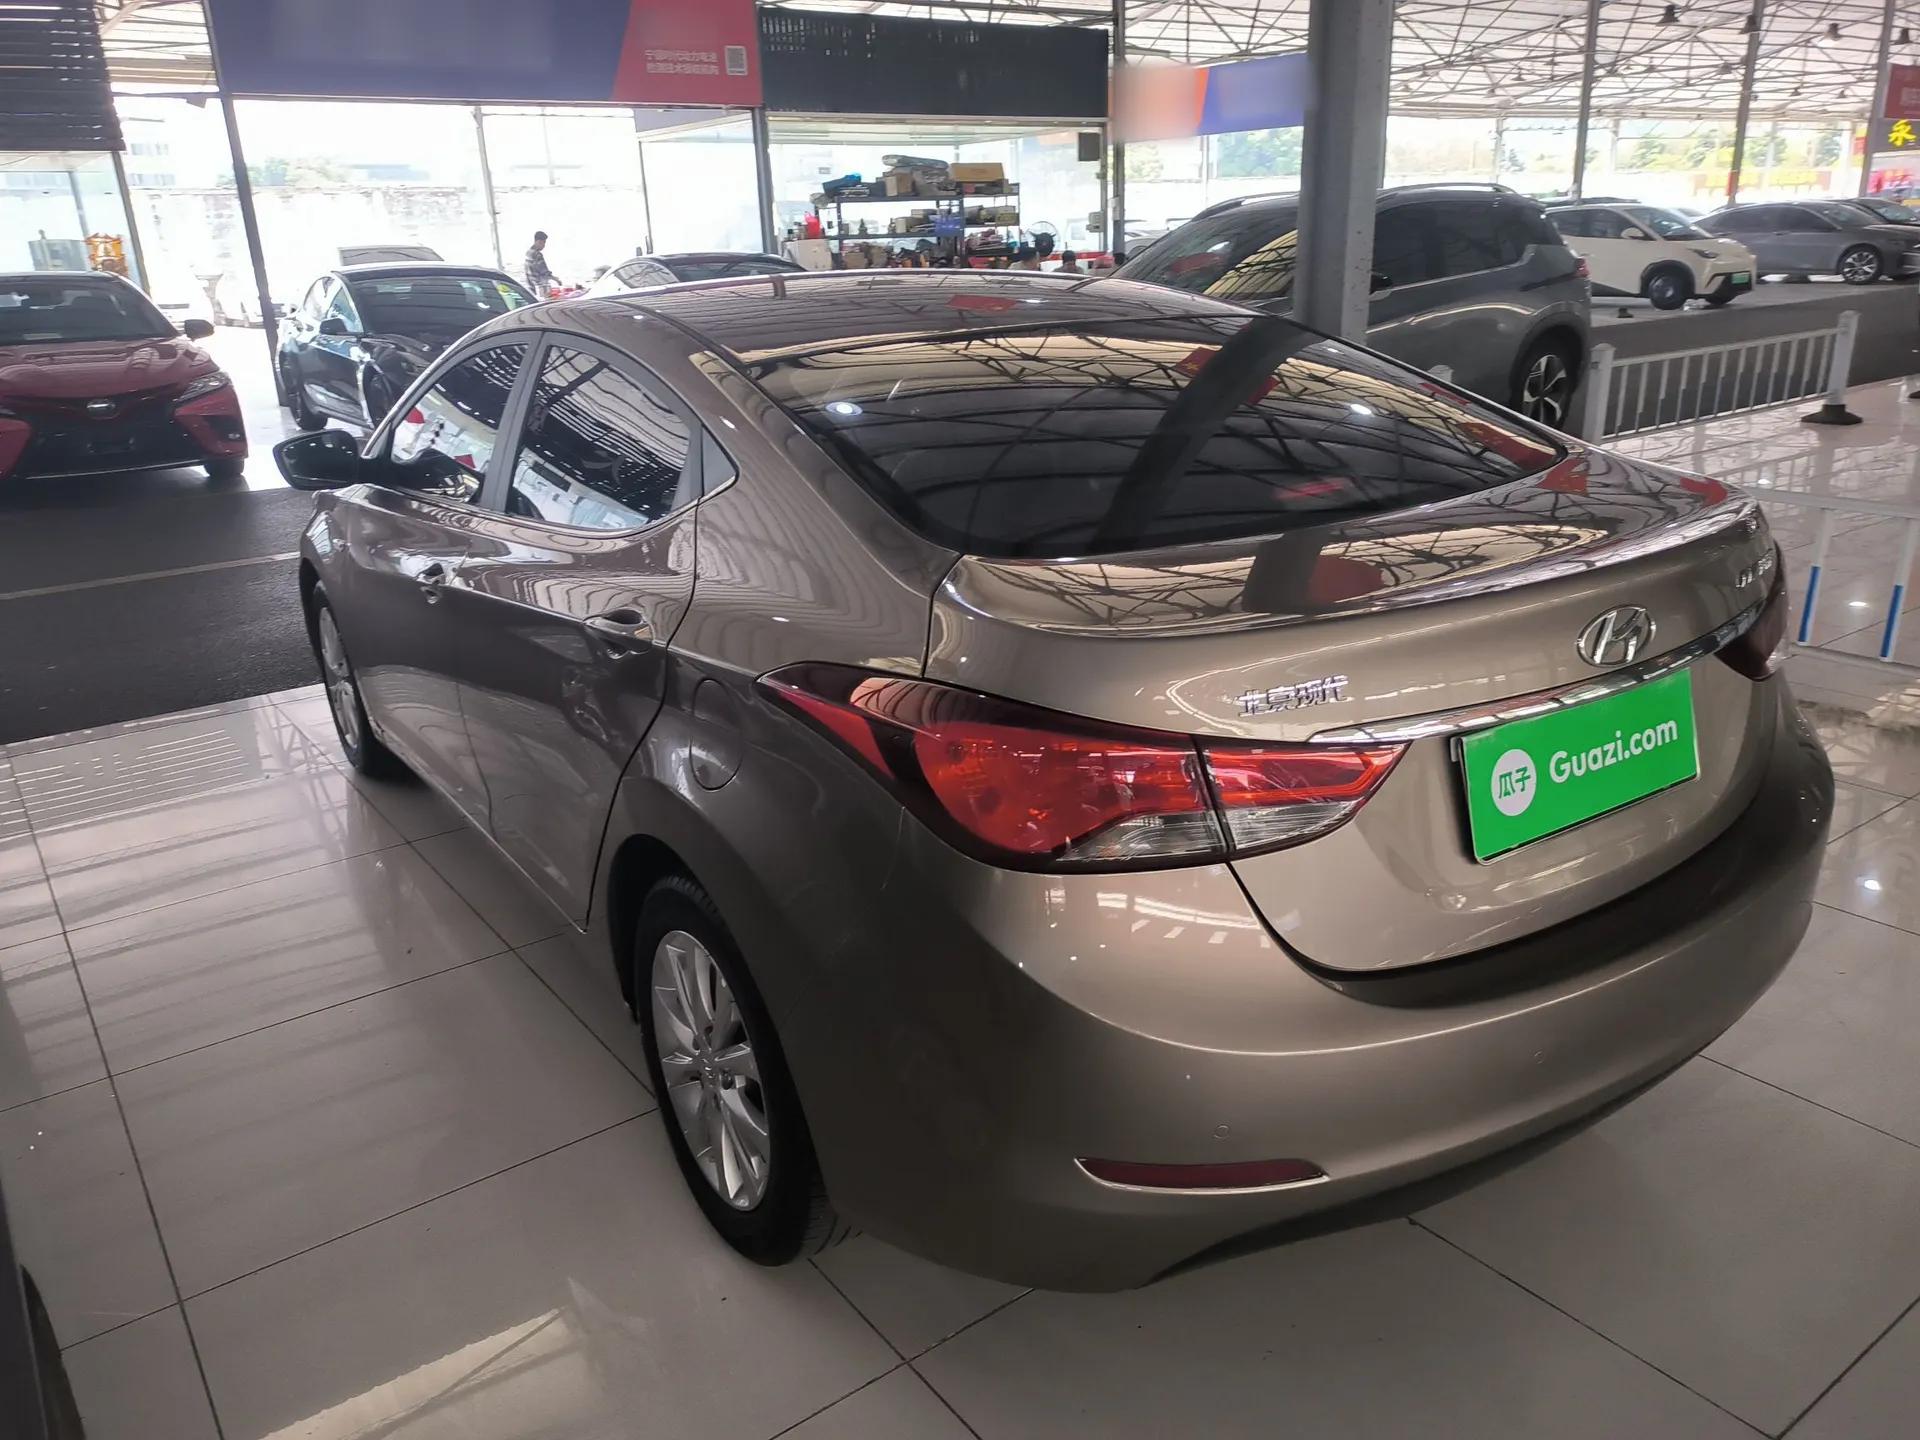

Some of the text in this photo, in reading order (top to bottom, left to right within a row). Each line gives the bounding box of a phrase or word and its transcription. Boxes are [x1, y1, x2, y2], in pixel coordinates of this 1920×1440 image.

[1234, 675, 1350, 716] 北京现代
[1549, 720, 1678, 783] Guazi.com
[1498, 765, 1532, 799] 瓜子
